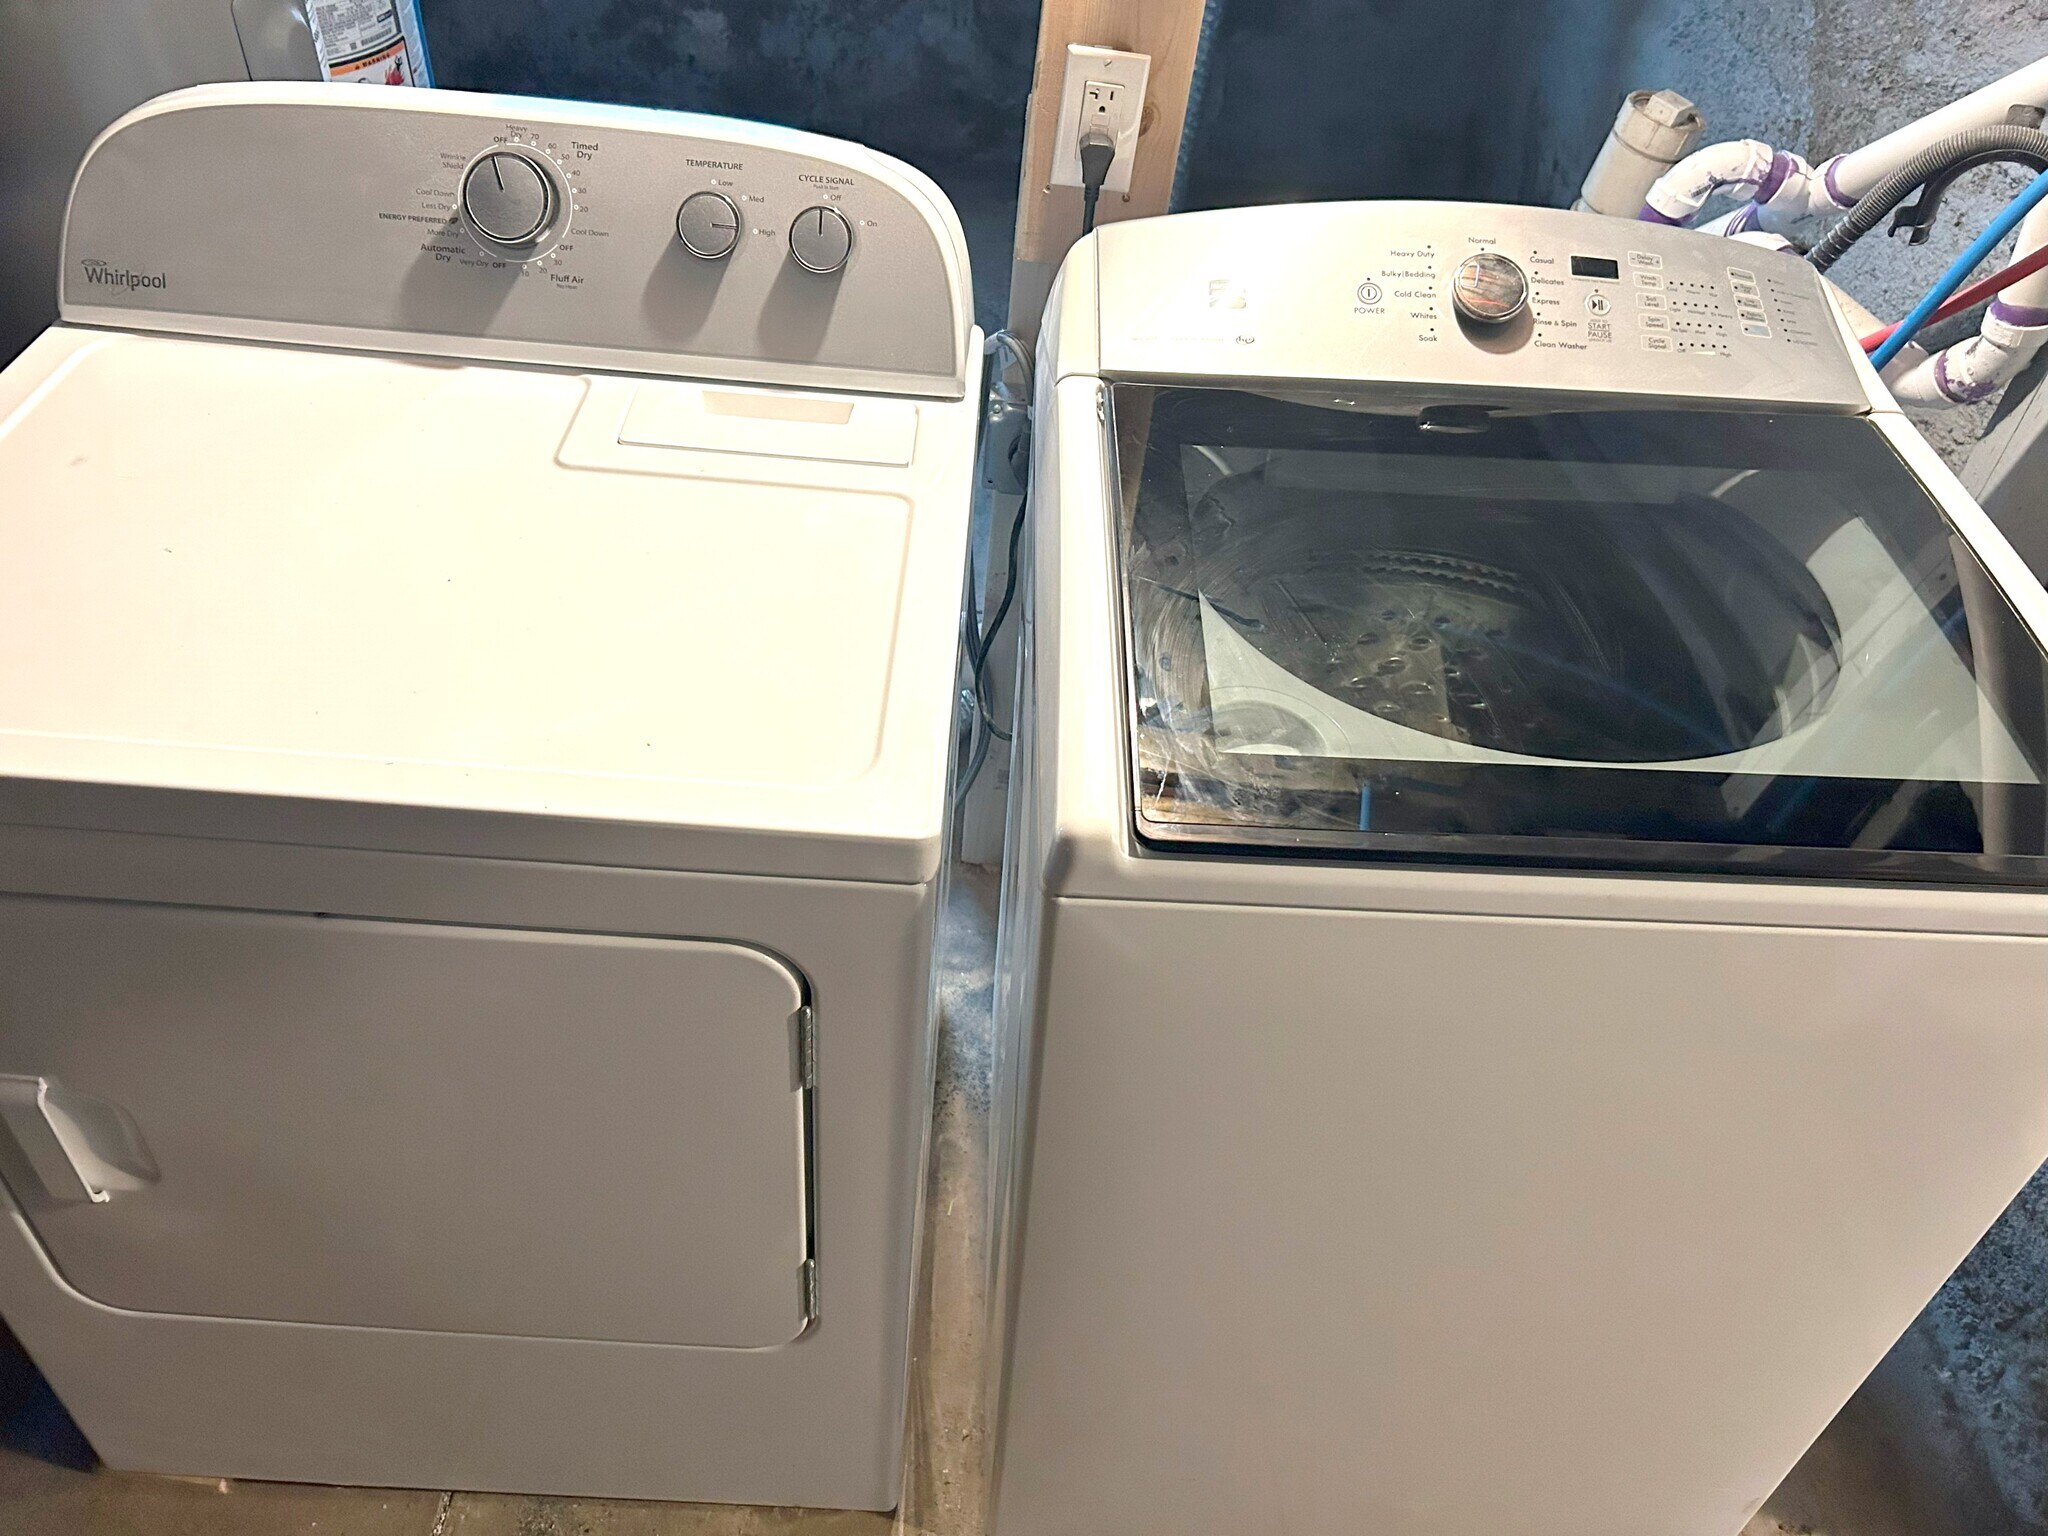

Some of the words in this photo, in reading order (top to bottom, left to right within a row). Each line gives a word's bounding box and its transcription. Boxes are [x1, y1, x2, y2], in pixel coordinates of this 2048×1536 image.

[506, 124, 527, 132] Heavy
[571, 142, 599, 151] Timed
[440, 152, 466, 160] Wrinkle
[576, 150, 592, 160] Dry
[685, 158, 744, 171] TEMPERATURE
[718, 179, 734, 187] Low
[798, 174, 824, 183] CYCLE
[826, 176, 854, 186] SIGNAL
[749, 194, 765, 203] Med
[438, 203, 451, 212] Dry
[378, 212, 406, 220] ENERGY
[408, 215, 448, 224] PREFERRED
[427, 228, 446, 236] More
[446, 230, 459, 238] Dry
[758, 228, 776, 237] High
[420, 243, 466, 254] Automatic
[436, 253, 452, 262] Dry
[1416, 250, 1435, 258] Duty
[460, 259, 474, 267] Very
[476, 260, 489, 268] Dry
[1530, 256, 1554, 264] Casual
[84, 266, 166, 291] Whirlpool
[550, 274, 570, 282] Fluff
[571, 276, 584, 284] Air
[1530, 277, 1564, 286] Delicates
[1532, 297, 1560, 305] Express
[1561, 320, 1577, 328] Spin
[1587, 330, 1612, 338] PAUSE
